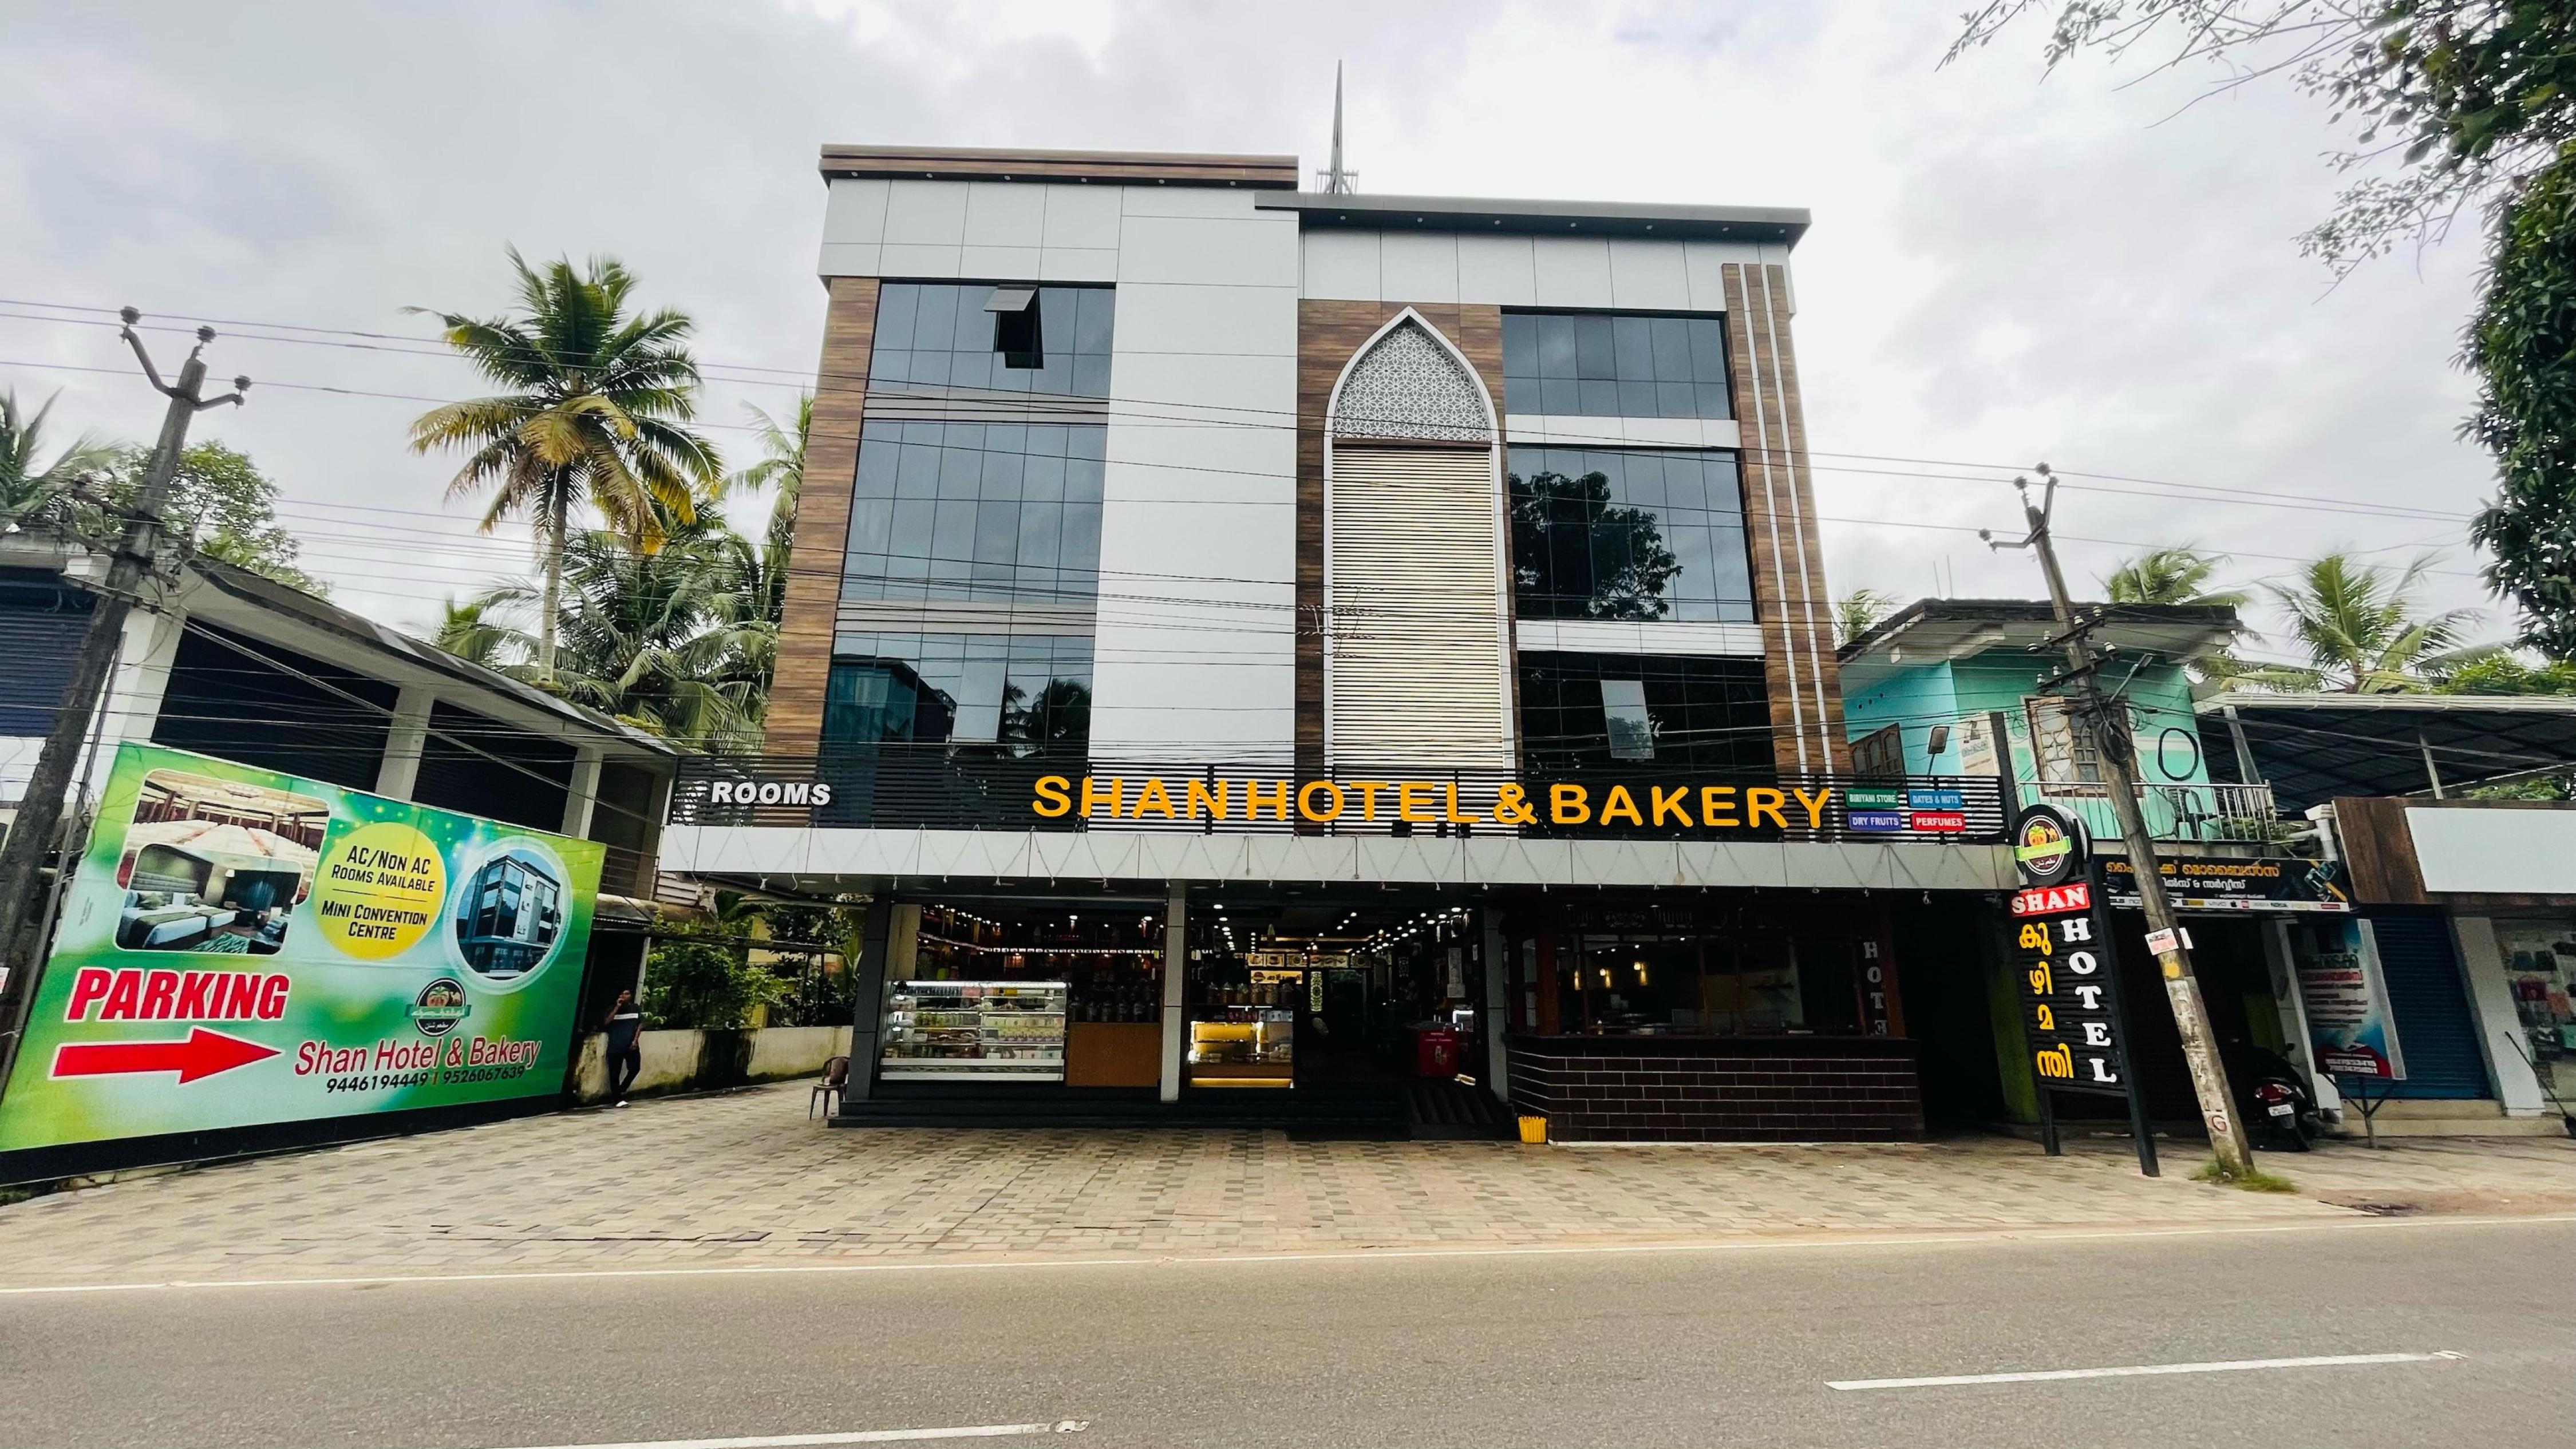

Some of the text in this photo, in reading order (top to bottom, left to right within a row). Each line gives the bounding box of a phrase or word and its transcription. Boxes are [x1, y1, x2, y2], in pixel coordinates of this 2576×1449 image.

[711, 781, 831, 805] ROOMS
[1032, 775, 1831, 829] SHAN HOTEL & BAKERY
[1876, 794, 1896, 803] STORE
[1913, 795, 1959, 804] DATES & NUTS
[1852, 817, 1899, 826] DRY FRUITS
[1915, 817, 1963, 826] PERFUMES
[410, 857, 430, 874] AC
[2012, 886, 2085, 914] SHAN
[68, 969, 290, 1020] PARKING
[2060, 917, 2117, 1083] HOTEL
[295, 1036, 541, 1075] Shan Hotel & Bakery
[326, 1072, 428, 1094] 9446194449
[443, 1066, 526, 1084] 9526067639
